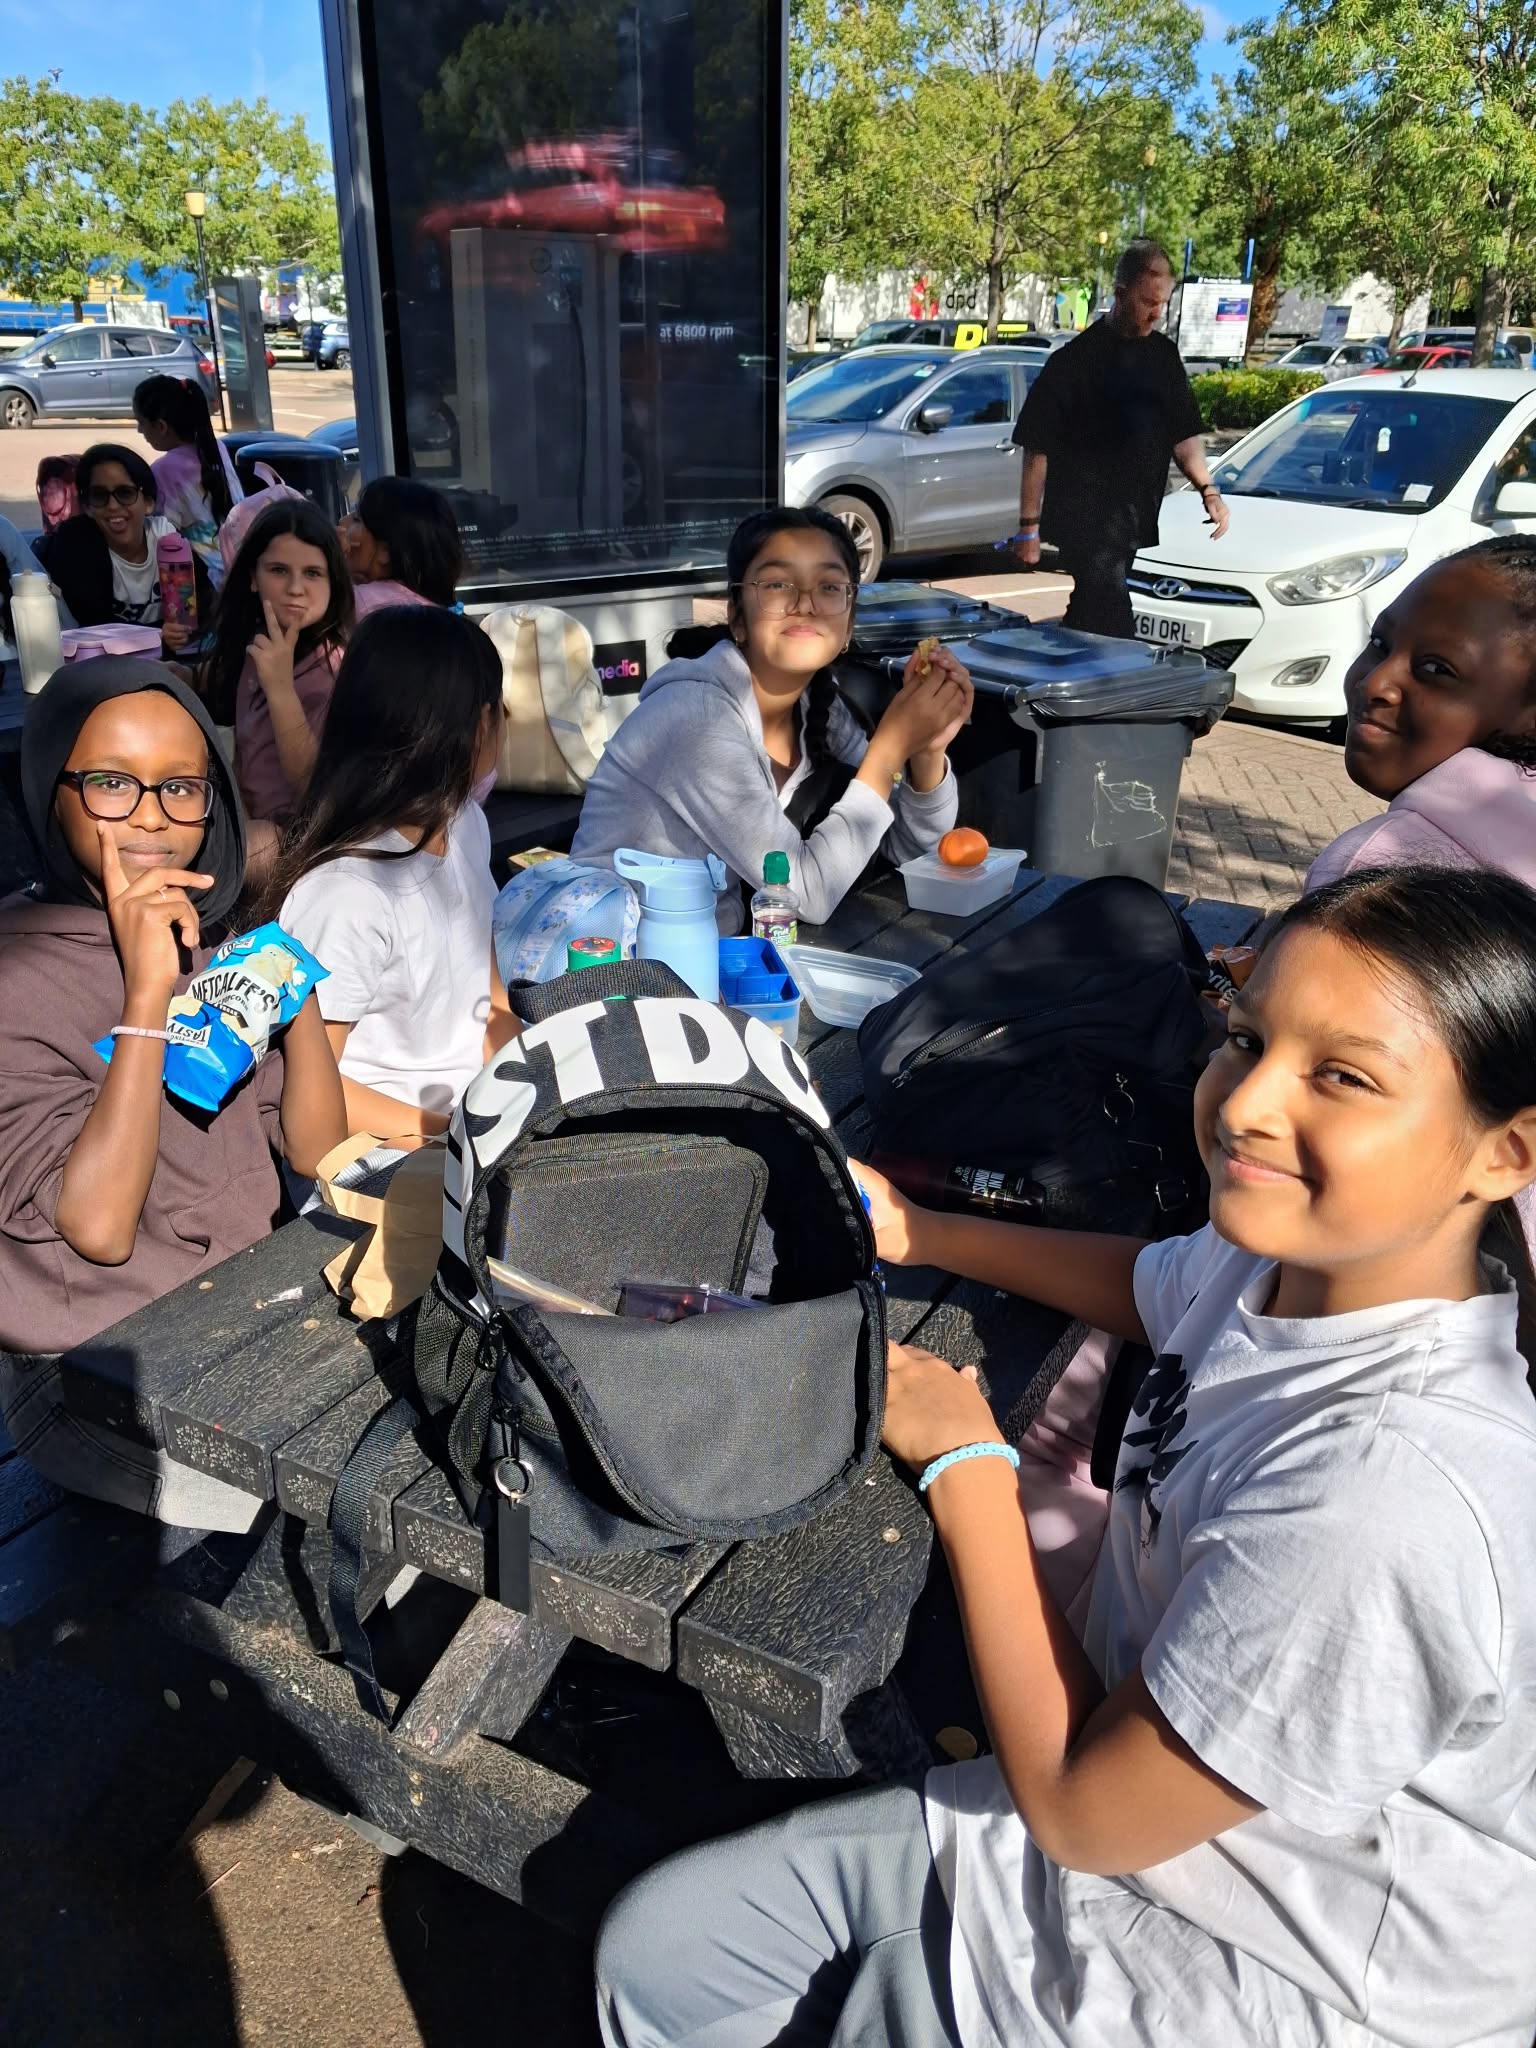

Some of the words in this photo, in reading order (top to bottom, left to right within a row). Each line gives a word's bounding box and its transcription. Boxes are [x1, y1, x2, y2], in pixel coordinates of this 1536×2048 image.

[659, 326, 672, 338] at
[674, 324, 707, 338] 6800
[709, 326, 734, 341] rpm
[1160, 619, 1192, 644] ORL
[191, 971, 276, 1013] METCALFE'S
[167, 1022, 207, 1043] TASTY
